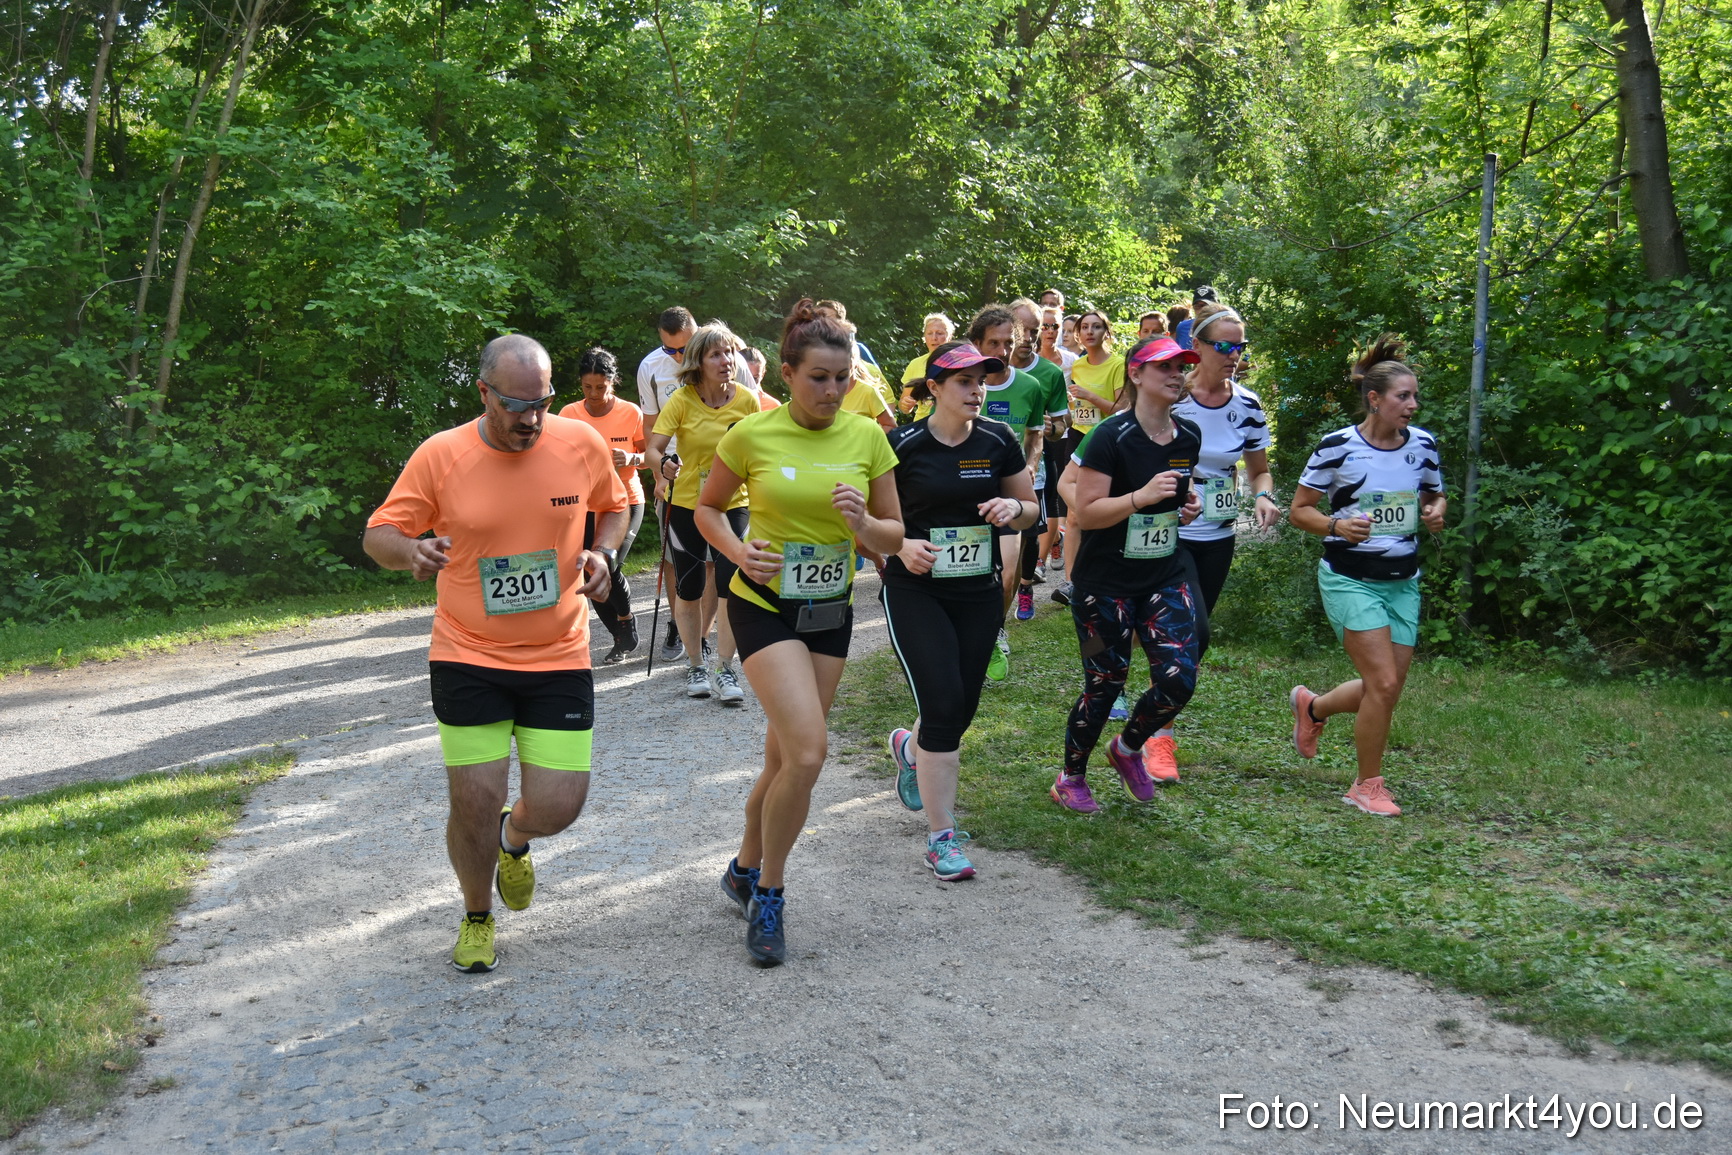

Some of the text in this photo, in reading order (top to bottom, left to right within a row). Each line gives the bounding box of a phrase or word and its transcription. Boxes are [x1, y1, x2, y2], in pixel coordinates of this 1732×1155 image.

[1075, 409, 1095, 418] 1231
[550, 495, 579, 506] THULE
[1373, 507, 1405, 524] 800
[1141, 529, 1169, 546] 143
[947, 544, 980, 563] 127
[792, 562, 843, 584] 1265
[490, 571, 547, 599] 2301
